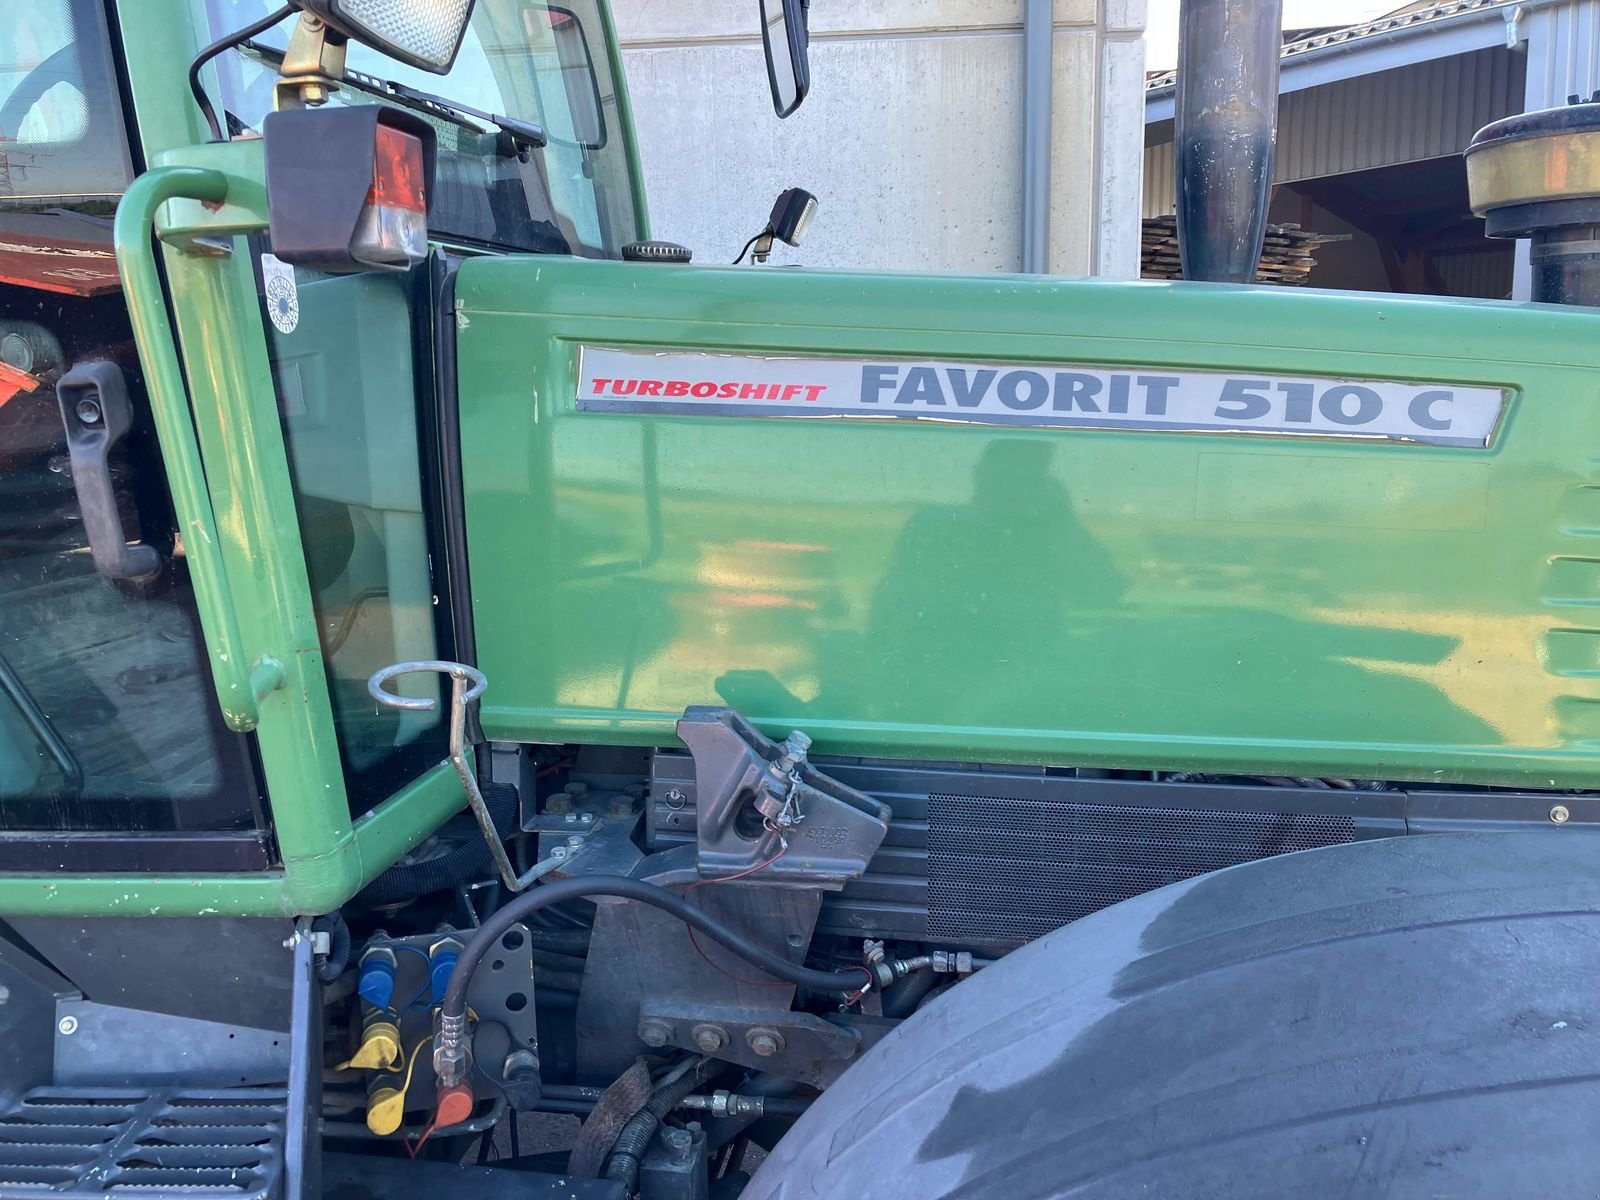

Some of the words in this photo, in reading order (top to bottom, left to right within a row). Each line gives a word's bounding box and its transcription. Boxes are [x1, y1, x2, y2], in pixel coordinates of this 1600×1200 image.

[591, 378, 827, 402] TURBOSHIFT
[860, 365, 1180, 415] FAVORIT
[1214, 379, 1384, 425] 510
[1407, 390, 1454, 431] C
